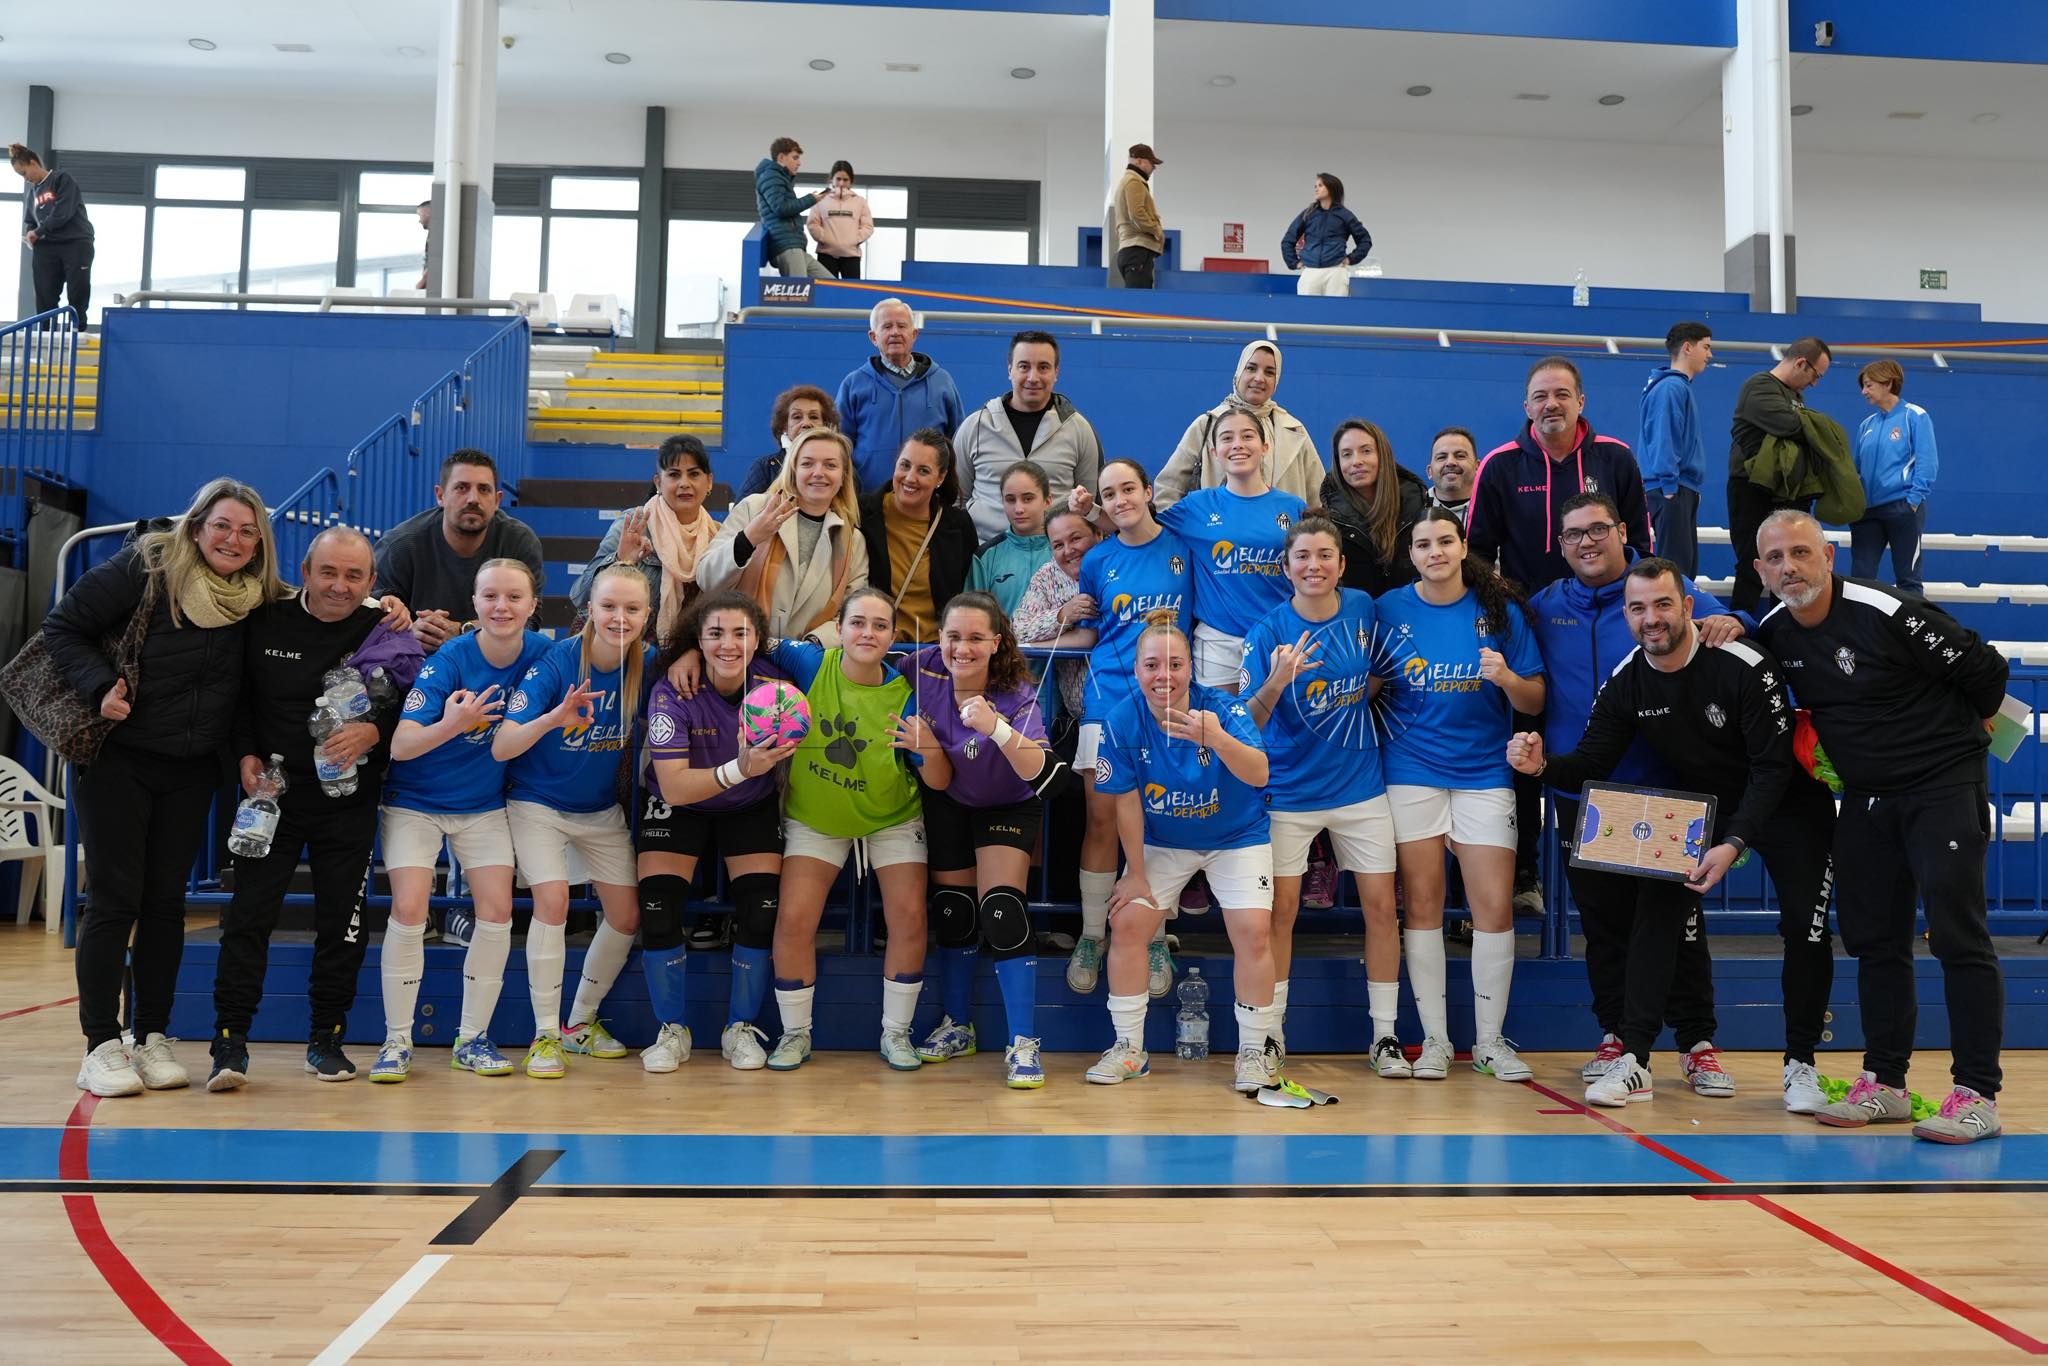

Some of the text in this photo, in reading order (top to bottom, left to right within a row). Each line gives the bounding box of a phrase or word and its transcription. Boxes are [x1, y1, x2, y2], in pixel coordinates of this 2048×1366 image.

[763, 283, 811, 298] MELILLA
[1551, 617, 1579, 626] KELME
[264, 648, 302, 660] KELME
[1433, 680, 1482, 693] DEPORTE
[600, 690, 617, 712] 14
[1637, 706, 1671, 718] KELME
[808, 761, 867, 793] KELME
[644, 795, 673, 820] 13
[989, 825, 1022, 835] KELME
[1808, 867, 1834, 943] KELME
